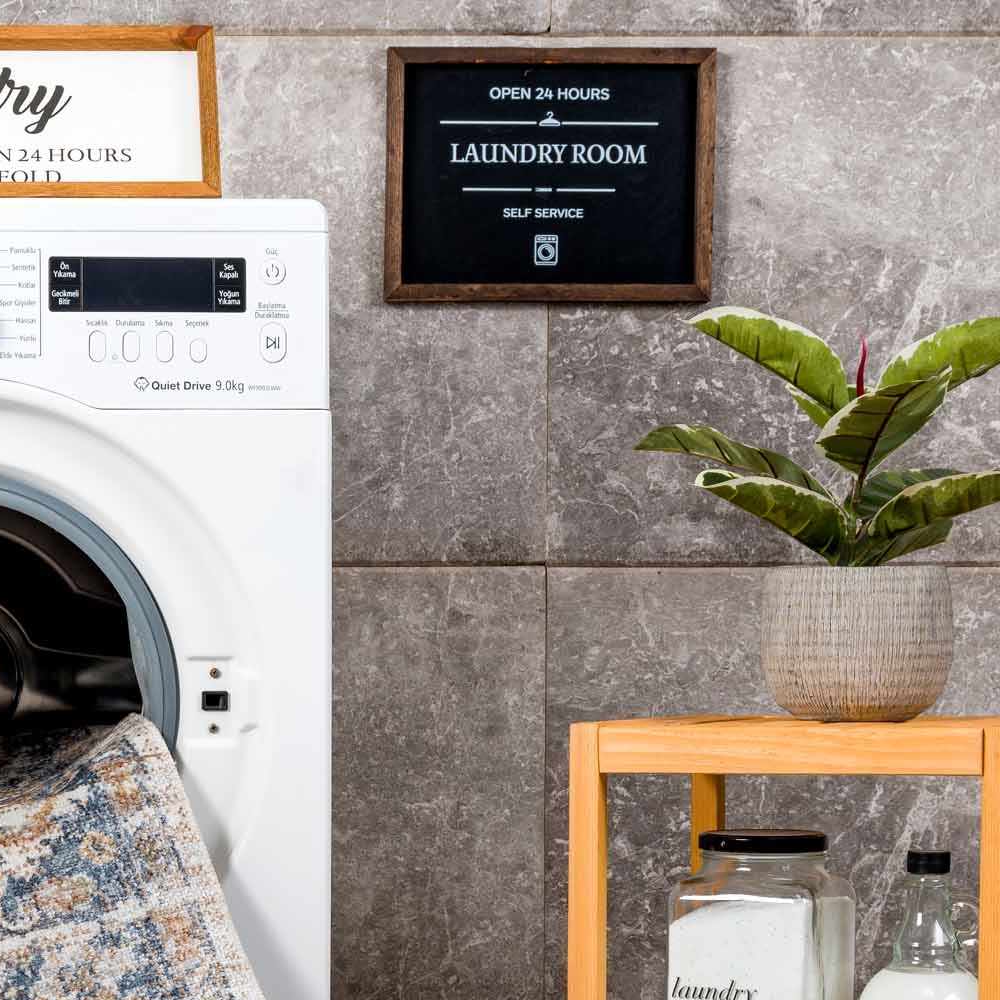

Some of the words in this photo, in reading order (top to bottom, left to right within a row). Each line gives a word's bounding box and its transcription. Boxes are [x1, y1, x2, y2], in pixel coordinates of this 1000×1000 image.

[489, 86, 532, 100] OPEN
[535, 87, 555, 101] 24
[557, 87, 611, 101] HOURS
[17, 148, 43, 162] 24
[48, 147, 132, 163] HOURS
[450, 143, 569, 164] LAUNDRY
[570, 143, 648, 165] ROOM
[502, 207, 533, 219] SELF
[534, 207, 585, 219] SERVICE
[60, 261, 70, 270] Ön
[224, 263, 236, 271] Ses
[152, 380, 180, 391] Quiet
[184, 380, 211, 391] Drive
[216, 379, 244, 394] 9.0kg
